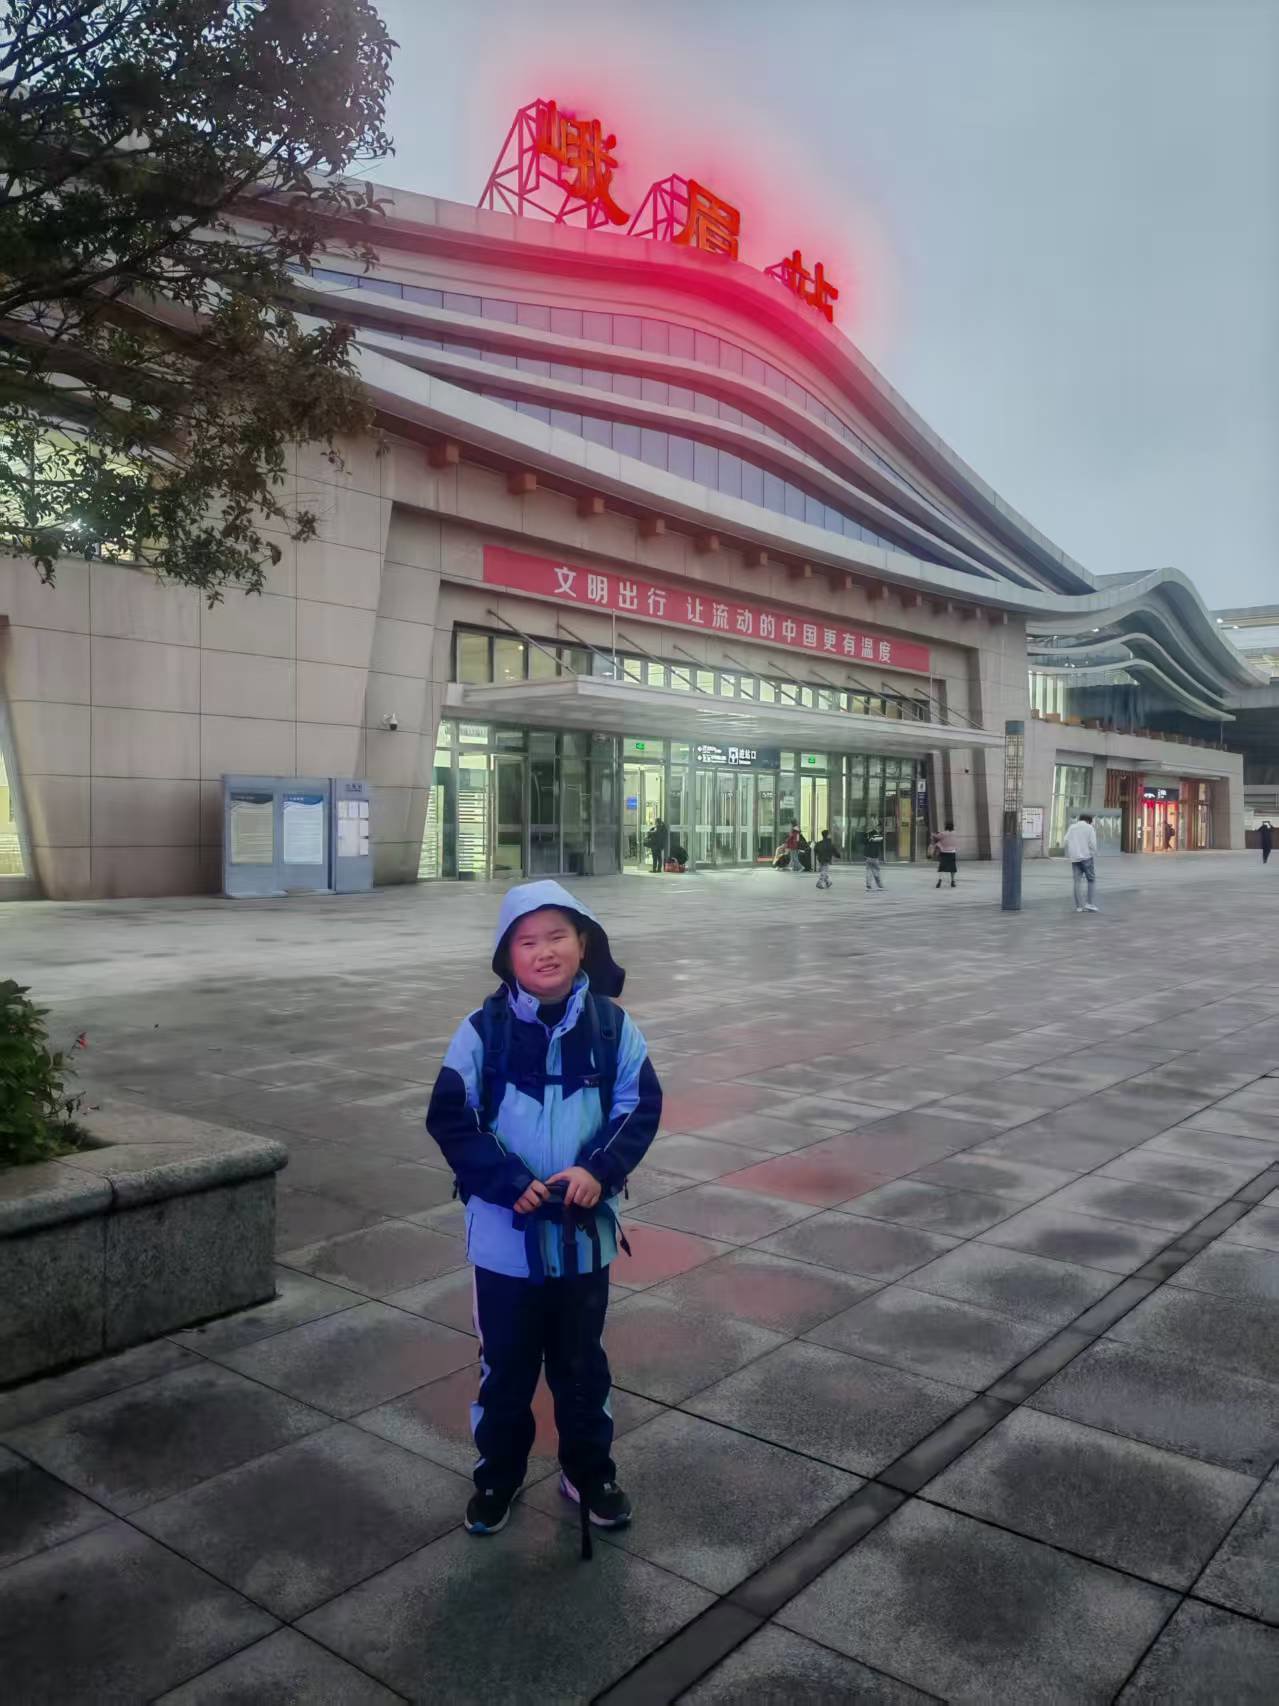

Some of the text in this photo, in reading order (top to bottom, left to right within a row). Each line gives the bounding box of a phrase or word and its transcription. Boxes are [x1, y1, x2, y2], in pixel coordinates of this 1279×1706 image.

[554, 566, 892, 663] 文明出行 让流动的中国更有温度
